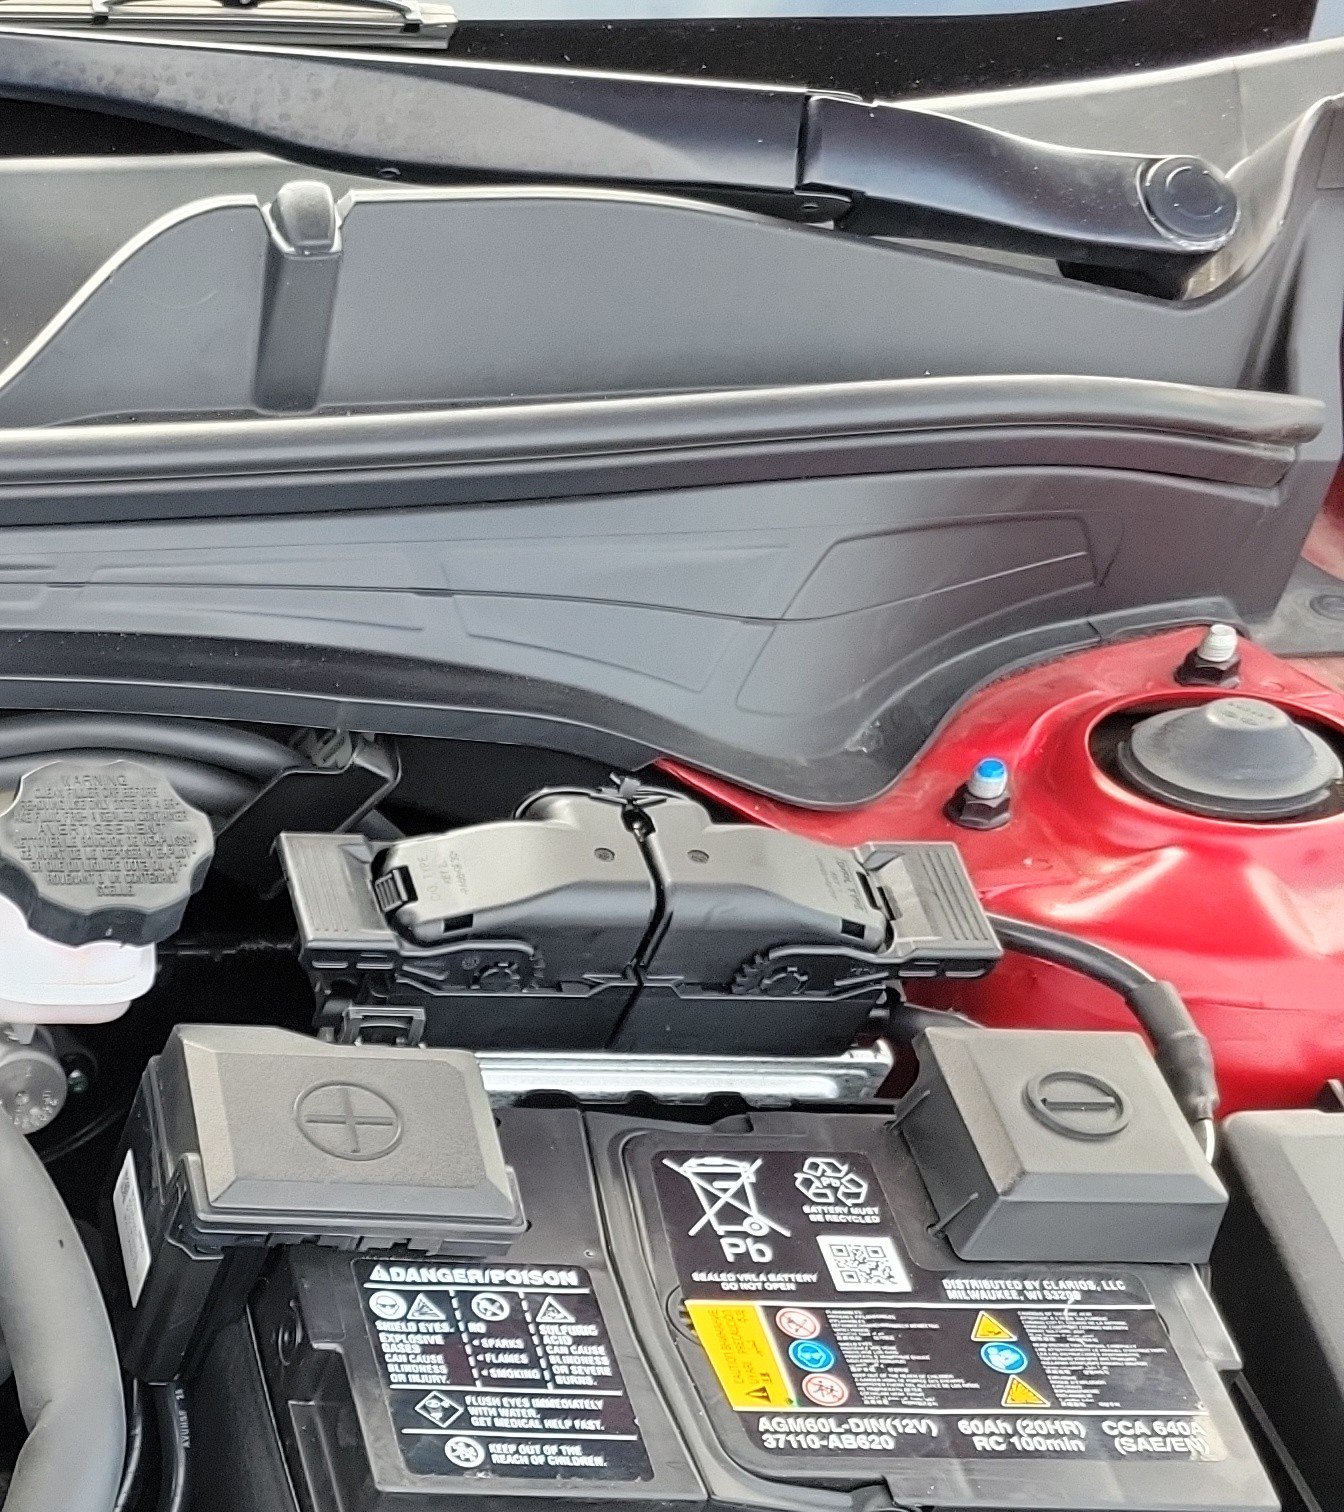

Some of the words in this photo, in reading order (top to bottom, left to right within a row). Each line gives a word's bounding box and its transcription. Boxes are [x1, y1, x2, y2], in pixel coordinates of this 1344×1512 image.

[802, 1204, 848, 1215] BATTERY
[850, 1206, 879, 1215] MUST
[809, 1214, 825, 1222] BE
[826, 1214, 880, 1224] RECYCLED
[720, 1236, 773, 1263] Pb
[389, 1266, 579, 1286] DANGER/POISON
[691, 1271, 737, 1282] SEALED
[738, 1272, 766, 1283] VRLA
[767, 1272, 819, 1283] BATTERY
[721, 1282, 738, 1291] DO
[740, 1282, 764, 1291] NOT
[765, 1282, 797, 1291] OPEN
[942, 1278, 1022, 1290] DISTRIBUTED
[1023, 1279, 1040, 1290] BY
[1043, 1280, 1101, 1291] CLARIOS,
[1102, 1280, 1126, 1291] LLC
[946, 1289, 1024, 1300] MILWAUKEE,
[1025, 1290, 1043, 1300] WI
[375, 1320, 417, 1332] SHIELD
[418, 1321, 455, 1333] EYES.
[467, 1321, 487, 1334] NO
[539, 1324, 598, 1336] SULFURIC
[379, 1332, 445, 1345] EXPLOSIVE
[481, 1337, 525, 1349] SPARKS
[543, 1335, 573, 1346] ACID
[381, 1343, 421, 1354] GASES
[546, 1345, 569, 1355] CAN
[570, 1345, 606, 1356] CAUSE
[385, 1353, 408, 1363] CAN
[409, 1354, 445, 1364] CAUSE
[485, 1352, 530, 1365] FLAMES
[549, 1355, 610, 1366] BLINDNESS
[387, 1363, 448, 1375] BLINDNESS
[489, 1367, 541, 1380] SMOKING
[552, 1364, 569, 1375] OR
[570, 1365, 613, 1377] SEVERE
[390, 1373, 407, 1383] OR
[555, 1375, 598, 1386] BURNS.
[464, 1395, 501, 1407] FLUSH
[502, 1396, 531, 1408] EYES
[531, 1397, 605, 1410] IMMEDIATELY
[467, 1406, 498, 1417] WITH
[498, 1407, 541, 1418] WATER.
[470, 1416, 493, 1427] GET
[493, 1417, 543, 1428] MEDICAL
[544, 1418, 573, 1430] HELP
[573, 1419, 606, 1431] FAST.
[758, 1416, 939, 1437] AGM60L-DIN(12V)
[958, 1418, 1013, 1435] 60Ah
[1016, 1419, 1087, 1439] (20HR)
[1101, 1420, 1151, 1436] CCA
[1152, 1420, 1206, 1436] 640A
[763, 1433, 895, 1450] 37110-AB620
[972, 1436, 1007, 1451] RC
[1010, 1436, 1086, 1452] 100min
[1114, 1436, 1210, 1455] (SAE/EN)
[488, 1443, 518, 1454] KEEP
[518, 1443, 542, 1455] OUT
[543, 1444, 558, 1455] OF
[559, 1444, 583, 1456] THE
[491, 1453, 530, 1465] REACH
[530, 1454, 546, 1466] OF
[547, 1455, 608, 1467] CHILDREN.
